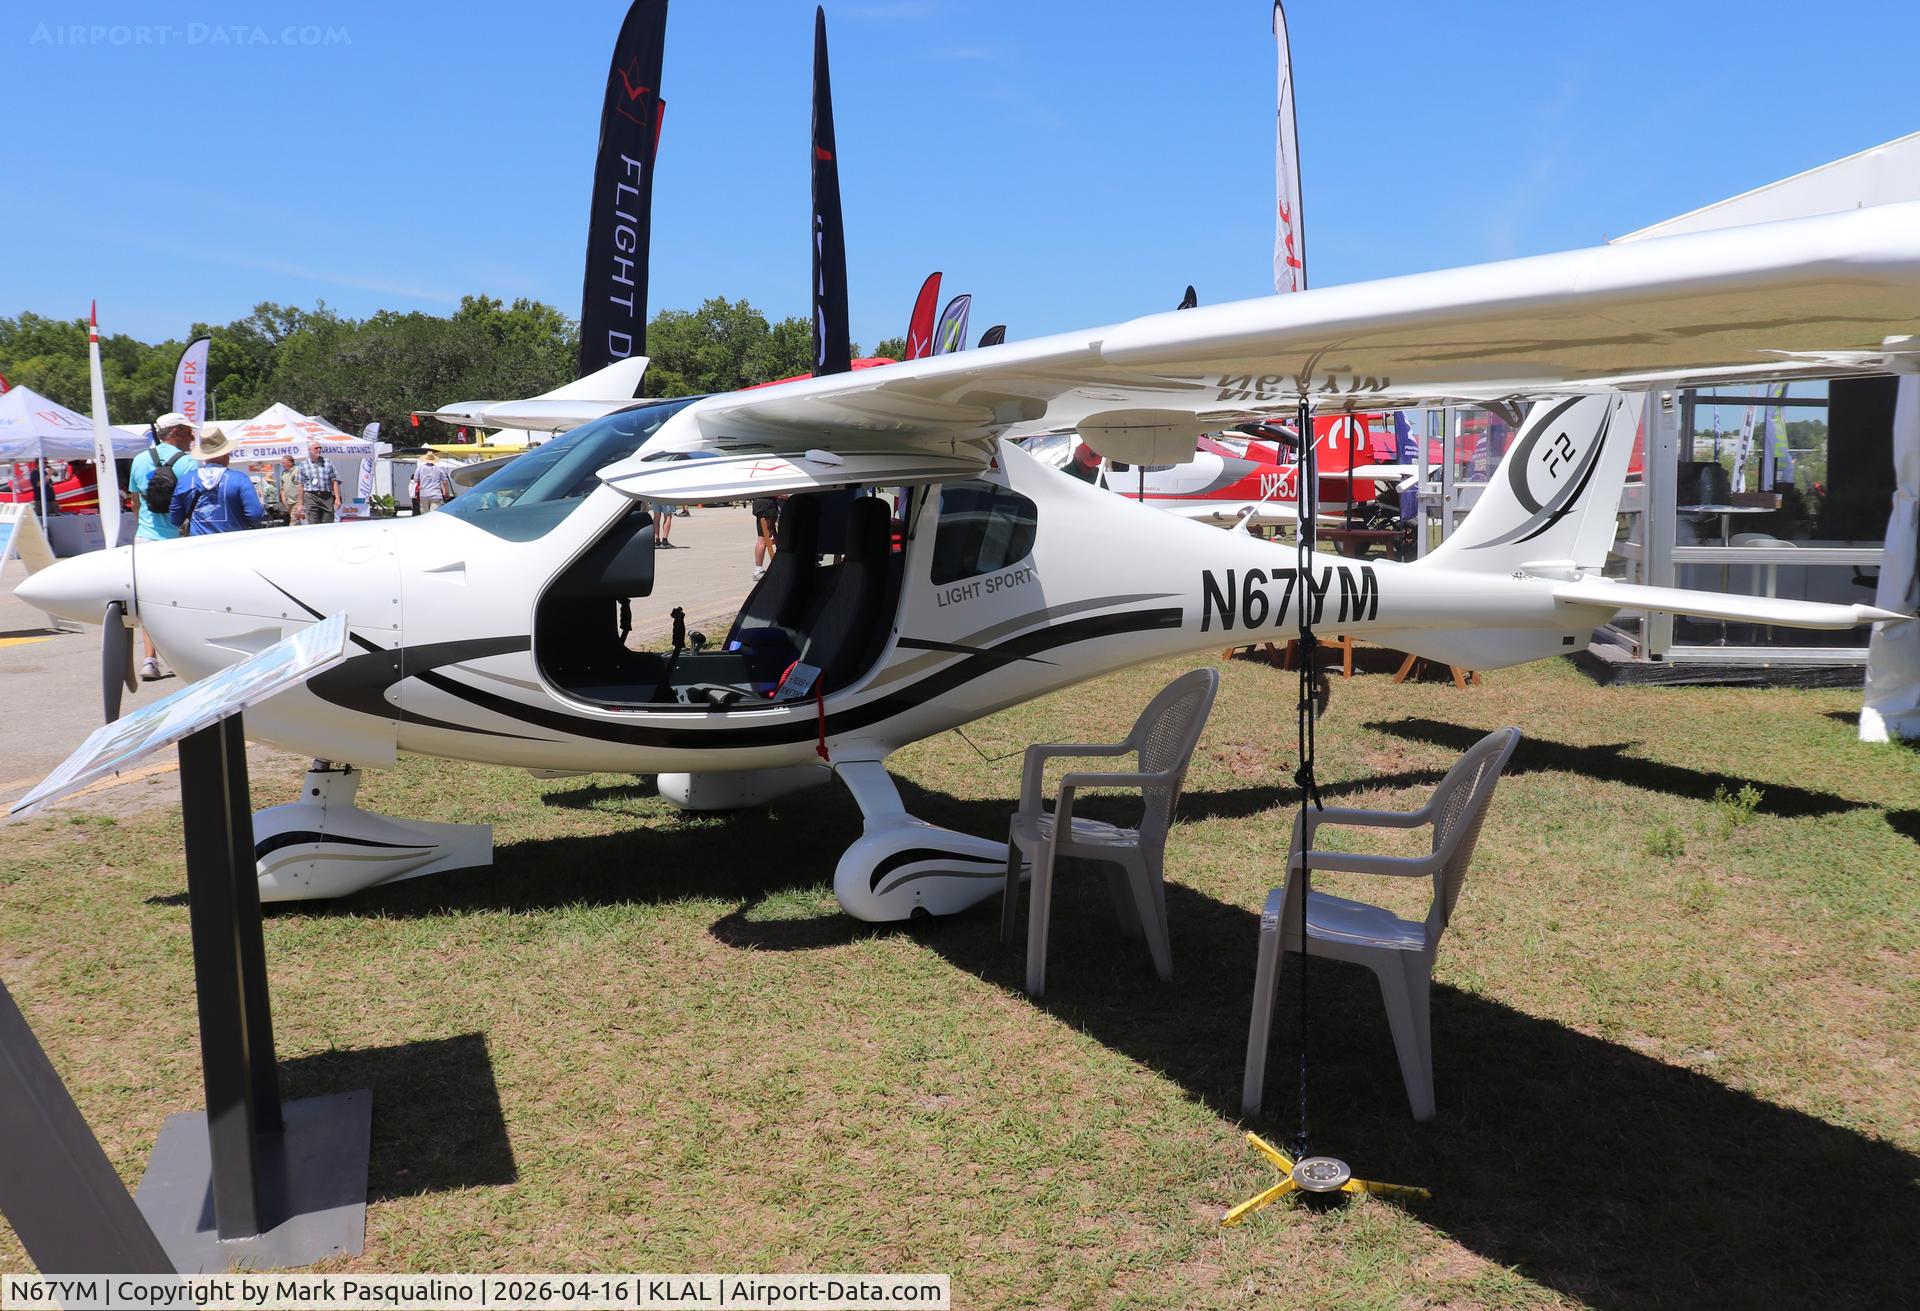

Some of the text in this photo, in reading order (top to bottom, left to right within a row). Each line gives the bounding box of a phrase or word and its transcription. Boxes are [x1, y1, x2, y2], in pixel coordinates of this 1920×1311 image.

[607, 153, 642, 366] FLIGHT D
[184, 361, 196, 384] FIX
[937, 567, 1033, 607] LIGHT SPORT
[1200, 565, 1379, 632] N67YM
